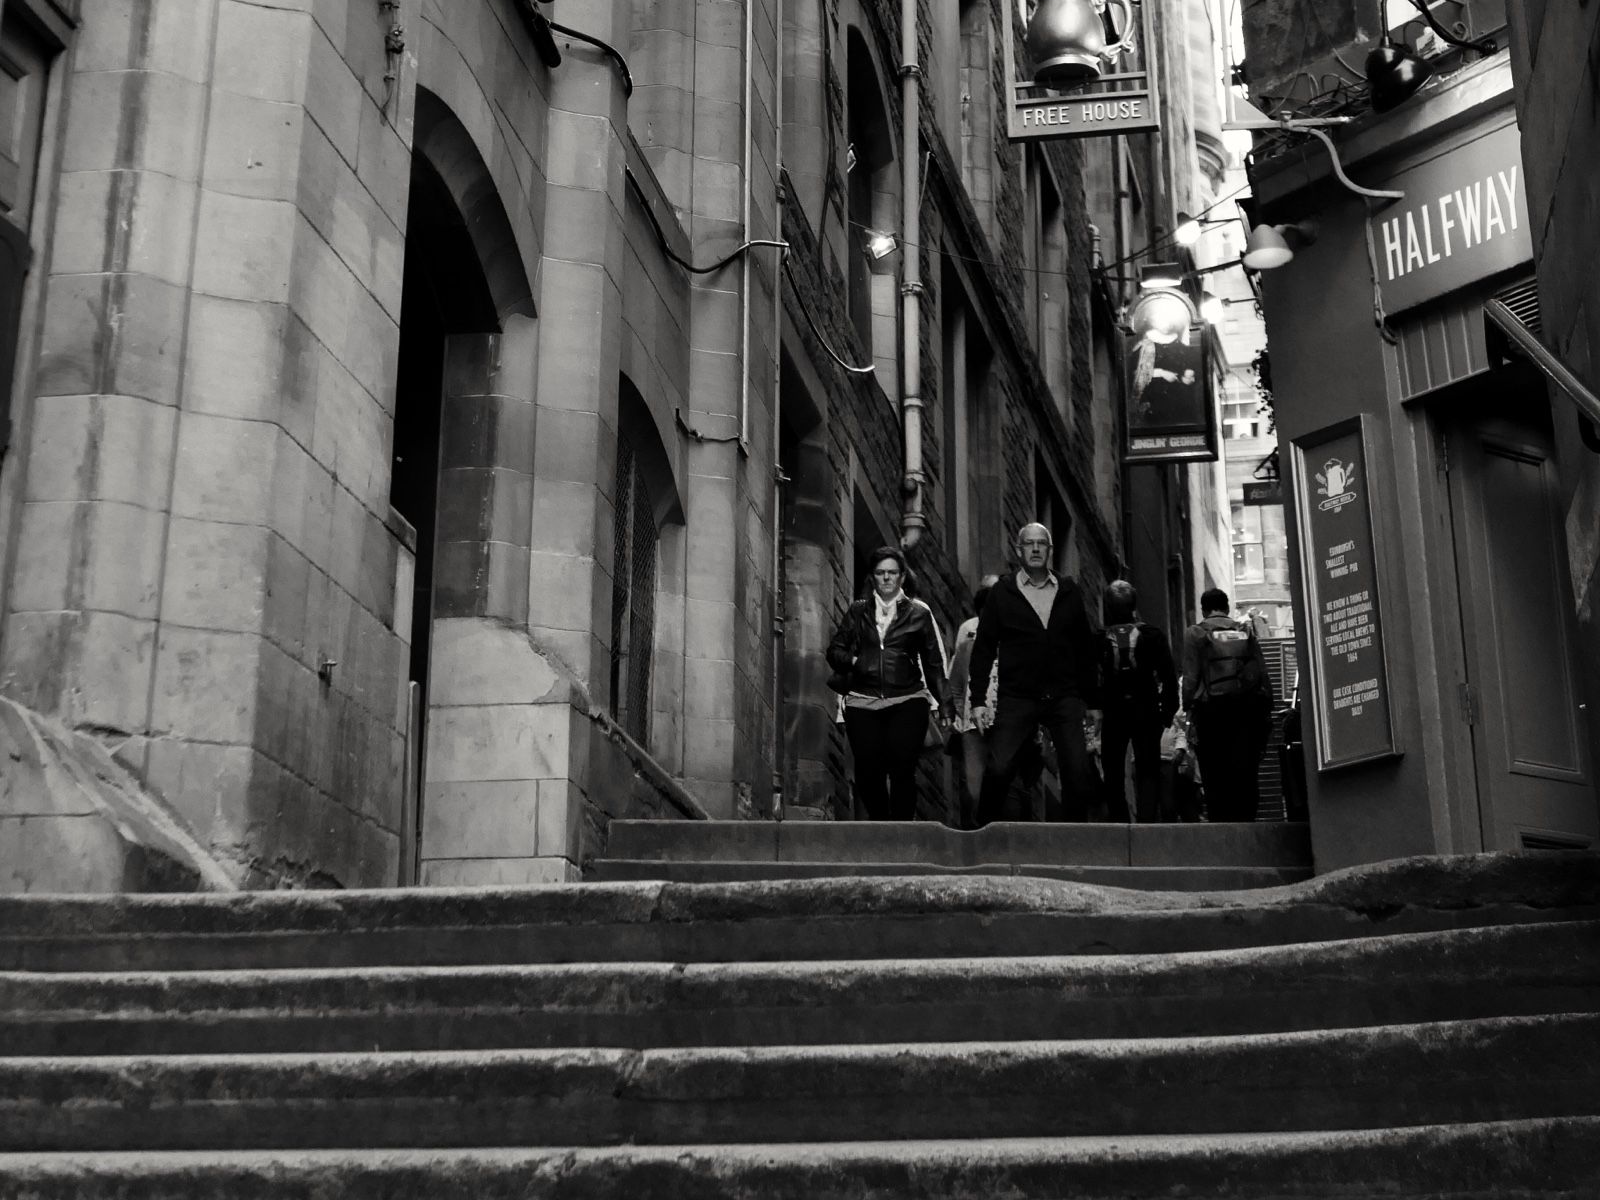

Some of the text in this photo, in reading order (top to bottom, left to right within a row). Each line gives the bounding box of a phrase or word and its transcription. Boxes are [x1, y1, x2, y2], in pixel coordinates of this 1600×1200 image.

[1023, 100, 1143, 127] FREE HOUSE
[1381, 165, 1519, 281] HALFWAY
[1131, 435, 1206, 450] JINGLIN' GEORDIE
